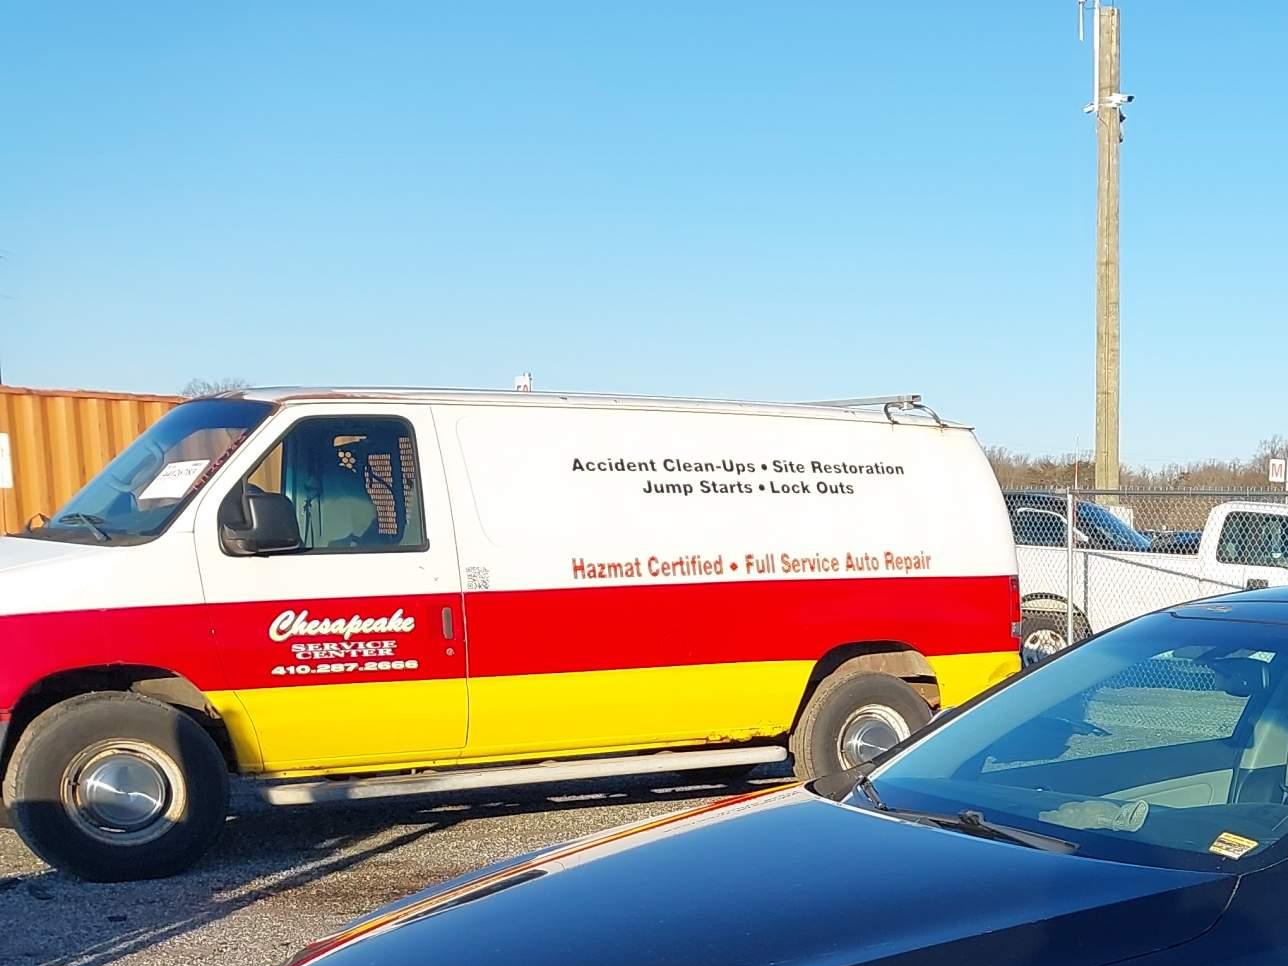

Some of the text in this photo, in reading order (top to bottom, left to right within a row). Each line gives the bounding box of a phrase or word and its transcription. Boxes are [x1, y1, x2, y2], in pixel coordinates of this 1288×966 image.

[572, 457, 658, 472] Accident
[663, 458, 756, 476] Clean-Ups
[772, 459, 805, 474] Site
[811, 460, 905, 475] Restoration
[643, 480, 694, 496] Jump
[700, 480, 753, 494] Starts
[770, 481, 812, 494] Lock
[816, 481, 855, 495] Outs
[571, 557, 643, 580] Hazmat
[647, 554, 724, 577] Certified
[744, 553, 776, 575] Full
[780, 552, 840, 574] Service
[845, 551, 880, 572] Auto
[884, 550, 932, 574] Repair
[268, 608, 416, 643] Chesapeake
[291, 640, 398, 653] SERVICE
[295, 648, 395, 660] CENTER
